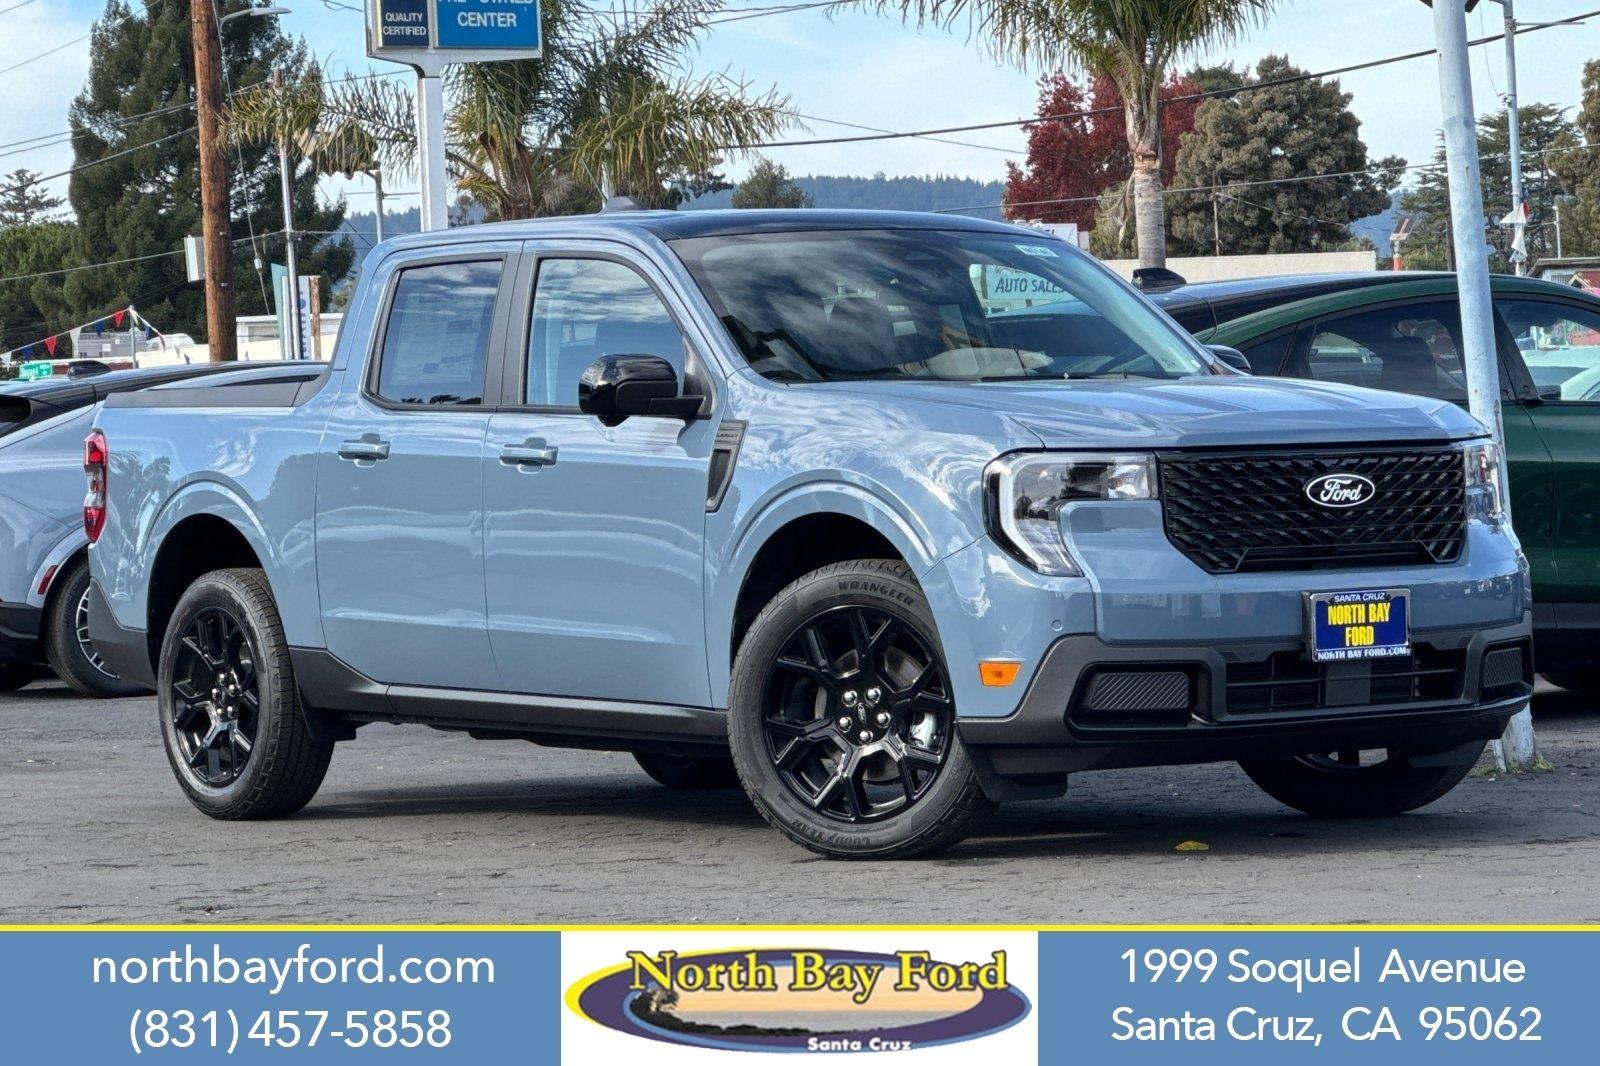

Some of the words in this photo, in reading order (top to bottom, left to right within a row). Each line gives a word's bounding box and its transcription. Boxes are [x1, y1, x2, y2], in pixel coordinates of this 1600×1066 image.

[385, 12, 423, 22] QUALITY
[457, 12, 517, 27] CENTER
[383, 26, 426, 36] CERTIFIED
[995, 278, 1028, 293] AUTO
[838, 580, 914, 607] WRANGLER
[1333, 594, 1361, 603] SANTA
[1362, 592, 1385, 602] CRUZ
[1327, 603, 1366, 626] NORTH
[1368, 602, 1391, 623] BAY
[1345, 626, 1375, 647] FORD
[1317, 650, 1346, 660] NORTH
[1347, 649, 1362, 659] BAY
[1364, 646, 1407, 657] FORD.COM
